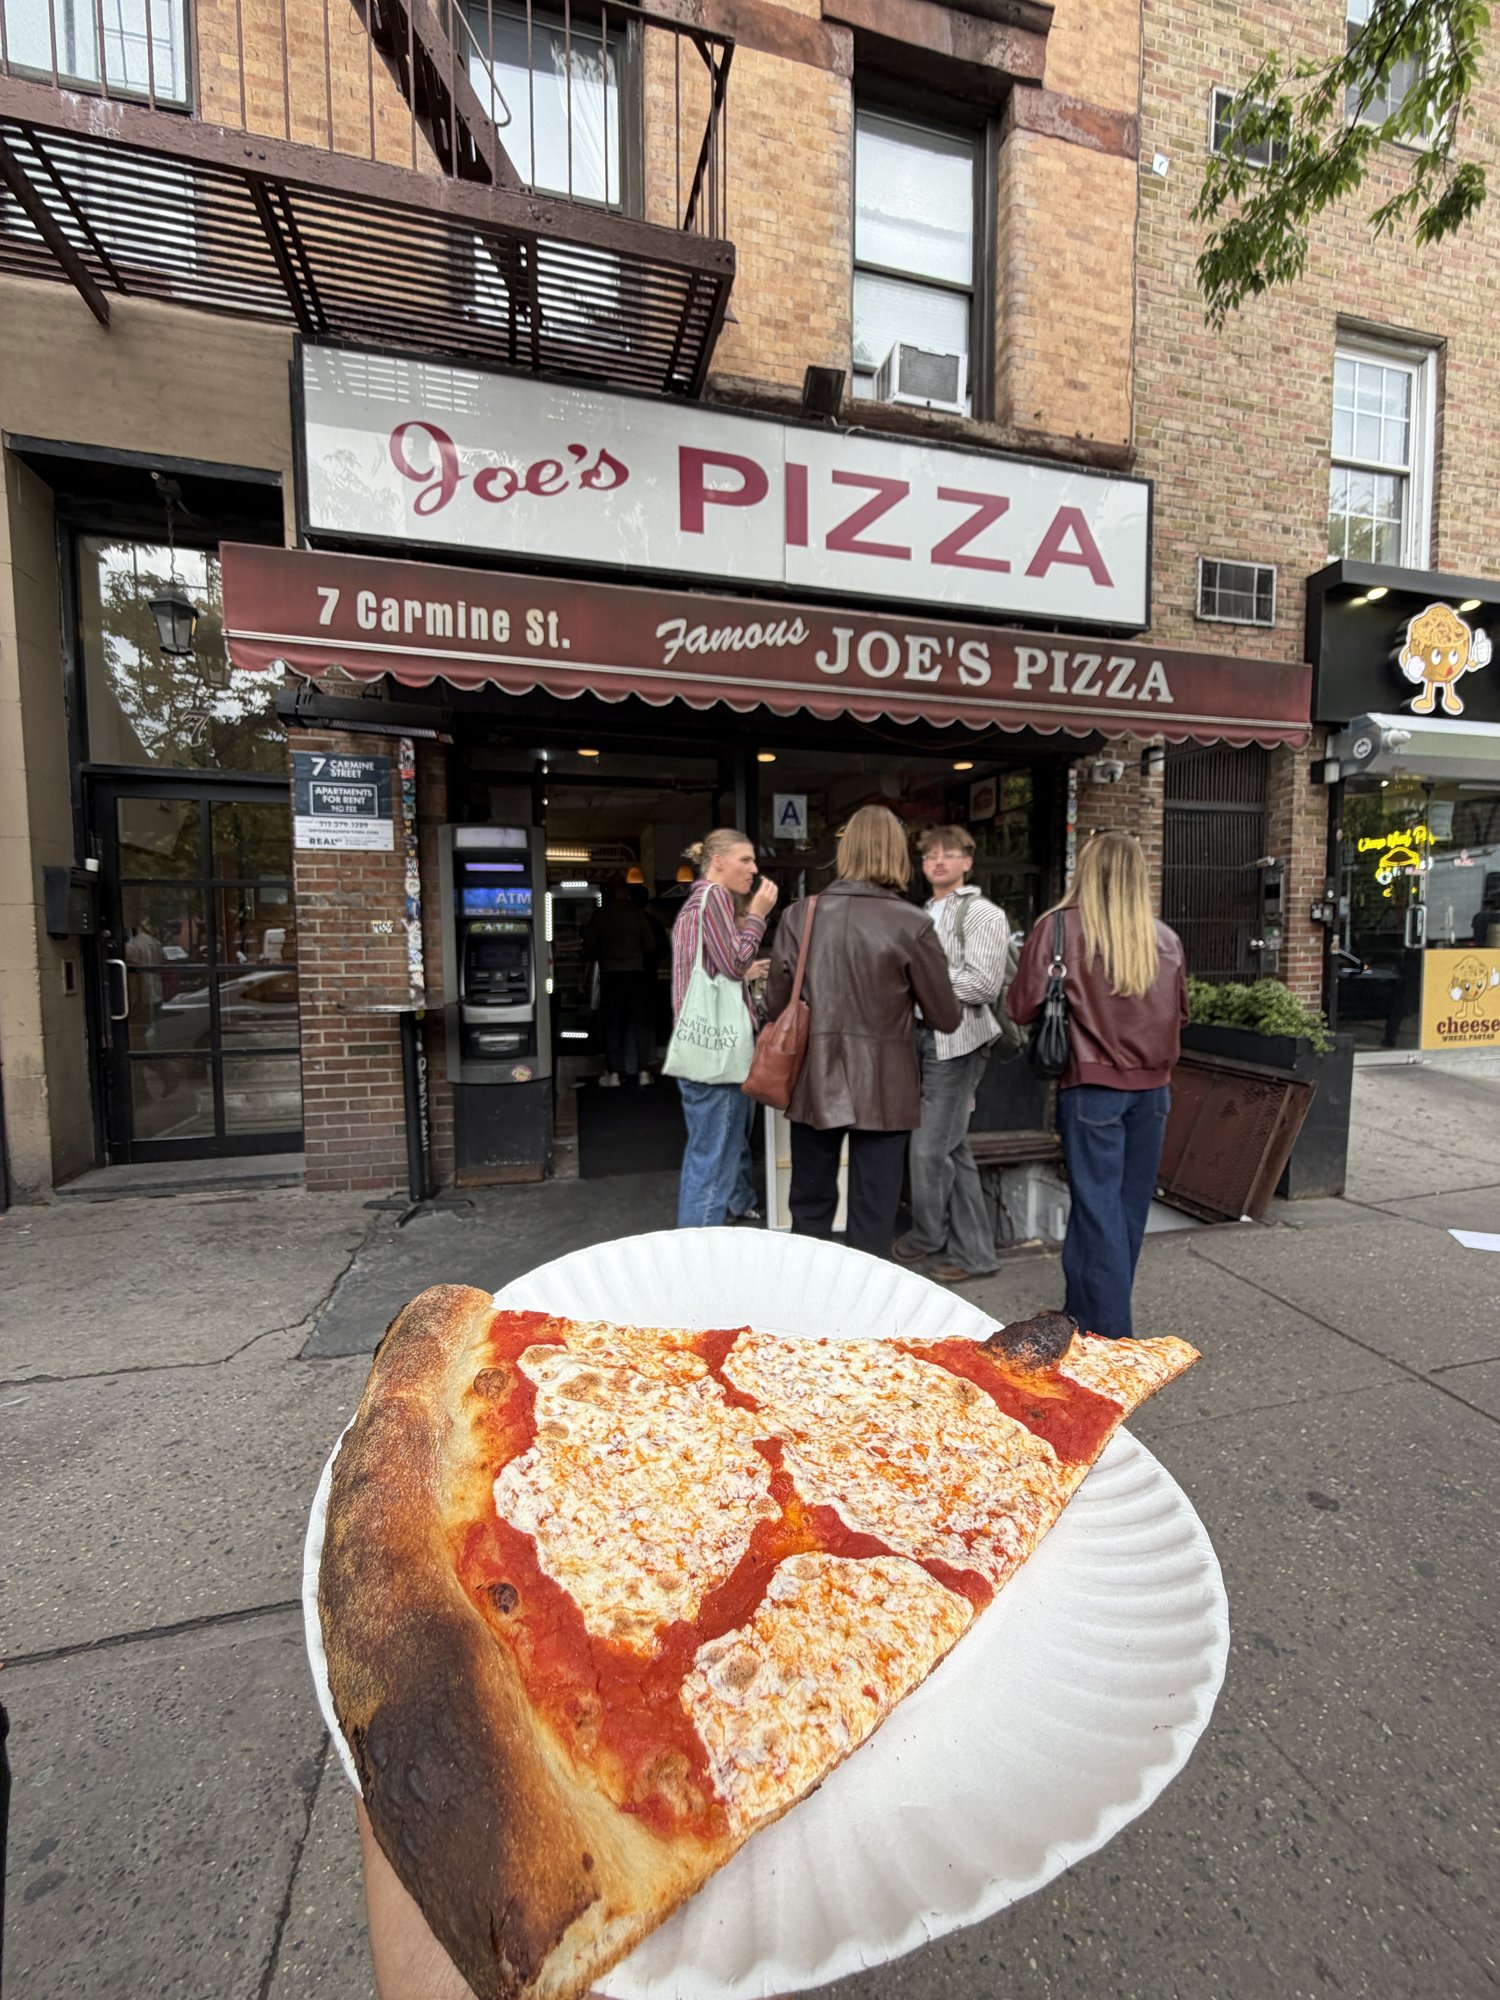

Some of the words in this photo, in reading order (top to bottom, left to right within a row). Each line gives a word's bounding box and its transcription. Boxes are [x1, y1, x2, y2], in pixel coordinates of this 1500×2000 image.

[389, 420, 630, 517] Joe's
[678, 445, 1115, 588] PIZZA
[317, 587, 340, 626] 7
[356, 590, 511, 643] Carmine
[525, 611, 571, 649] St.
[656, 616, 810, 664] Famous
[815, 627, 992, 687] JOE'S
[1013, 646, 1174, 704] PIZZA
[181, 708, 211, 748] 7
[310, 757, 327, 776] 7
[329, 759, 375, 771] CARMINE
[329, 769, 363, 778] STREET
[314, 786, 373, 797] APARTMENTS
[322, 796, 341, 804] FOR
[343, 797, 366, 805] RENT
[780, 800, 801, 826] A
[495, 892, 531, 904] ATM
[484, 923, 514, 932] ATM
[1436, 1016, 1500, 1036] cheese
